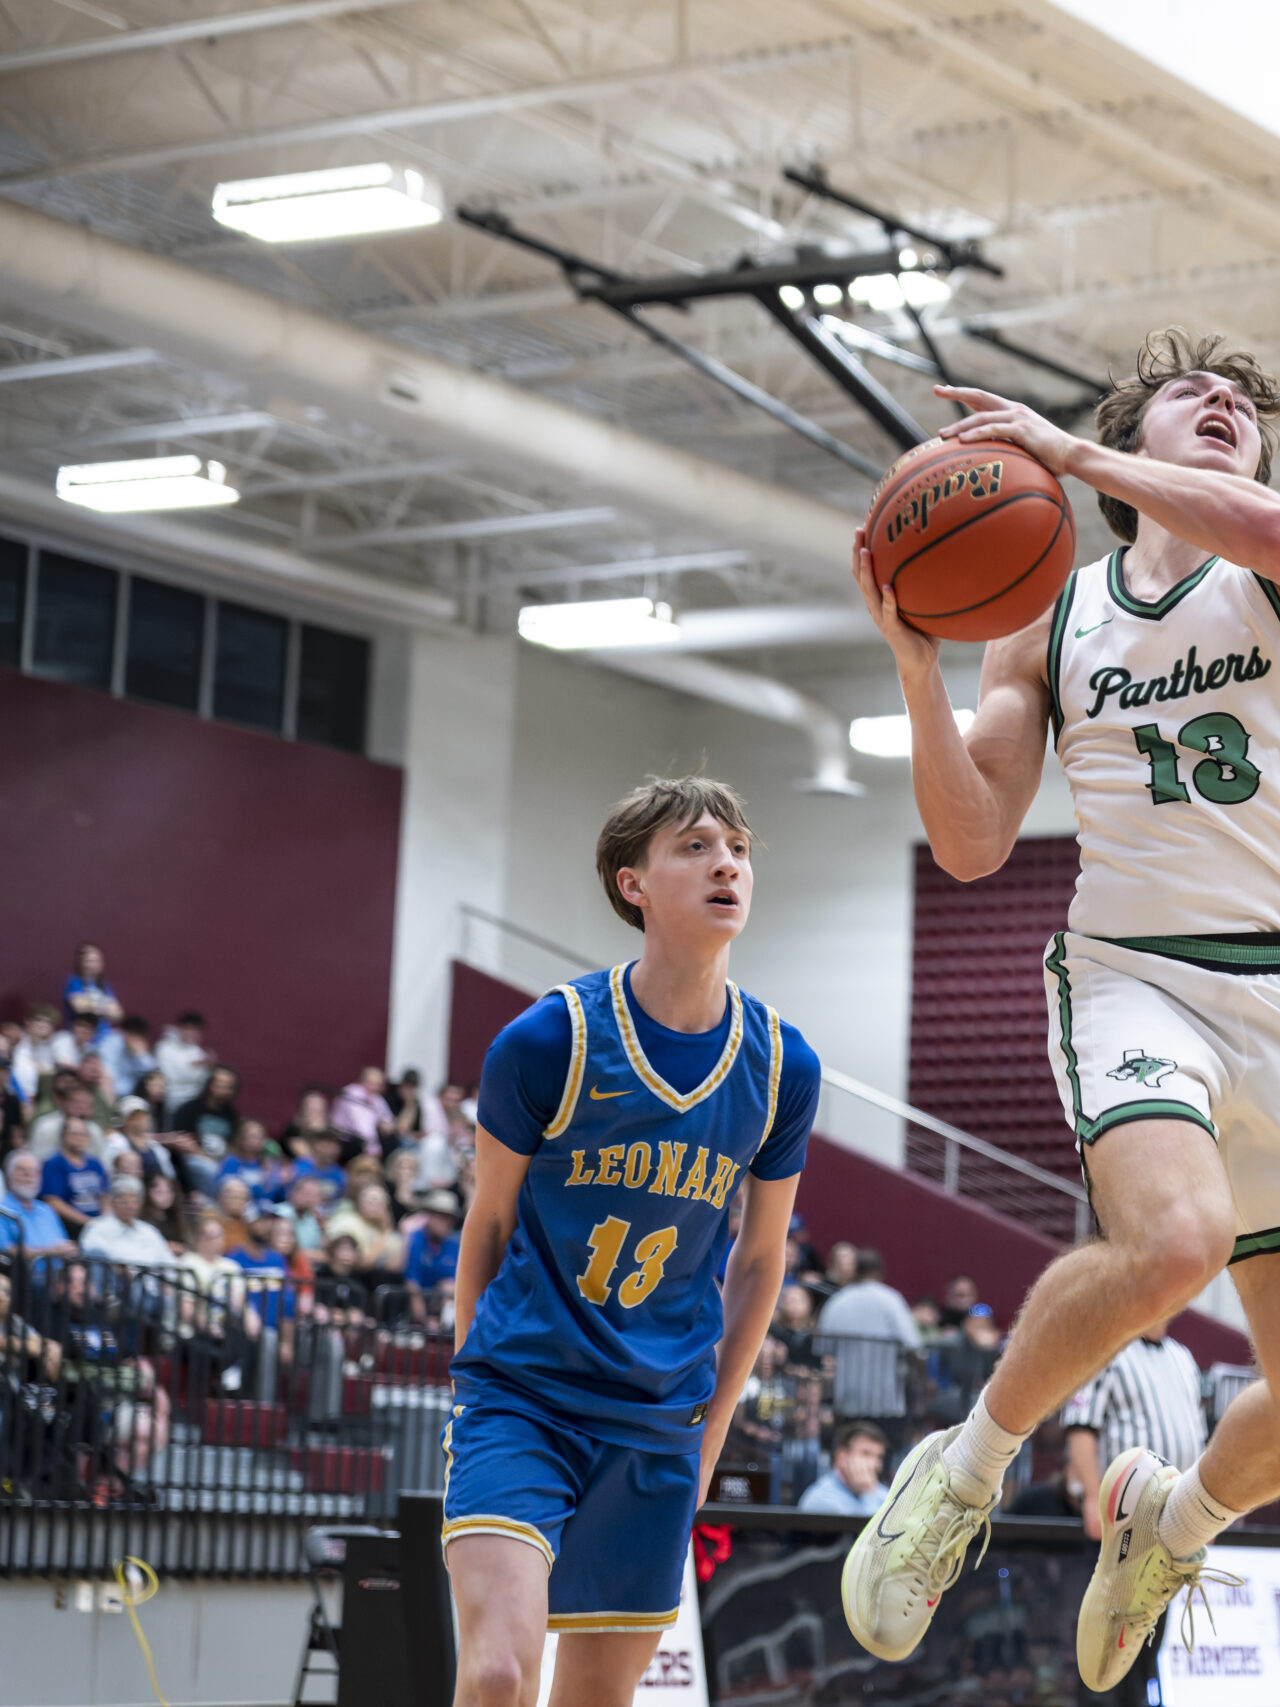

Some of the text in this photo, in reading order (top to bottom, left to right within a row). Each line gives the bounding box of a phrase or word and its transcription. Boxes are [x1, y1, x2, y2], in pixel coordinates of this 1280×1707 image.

[887, 460, 1003, 543] Baden
[1086, 645, 1272, 719] Panthers
[1131, 711, 1262, 806] 13
[576, 1214, 678, 1309] 13
